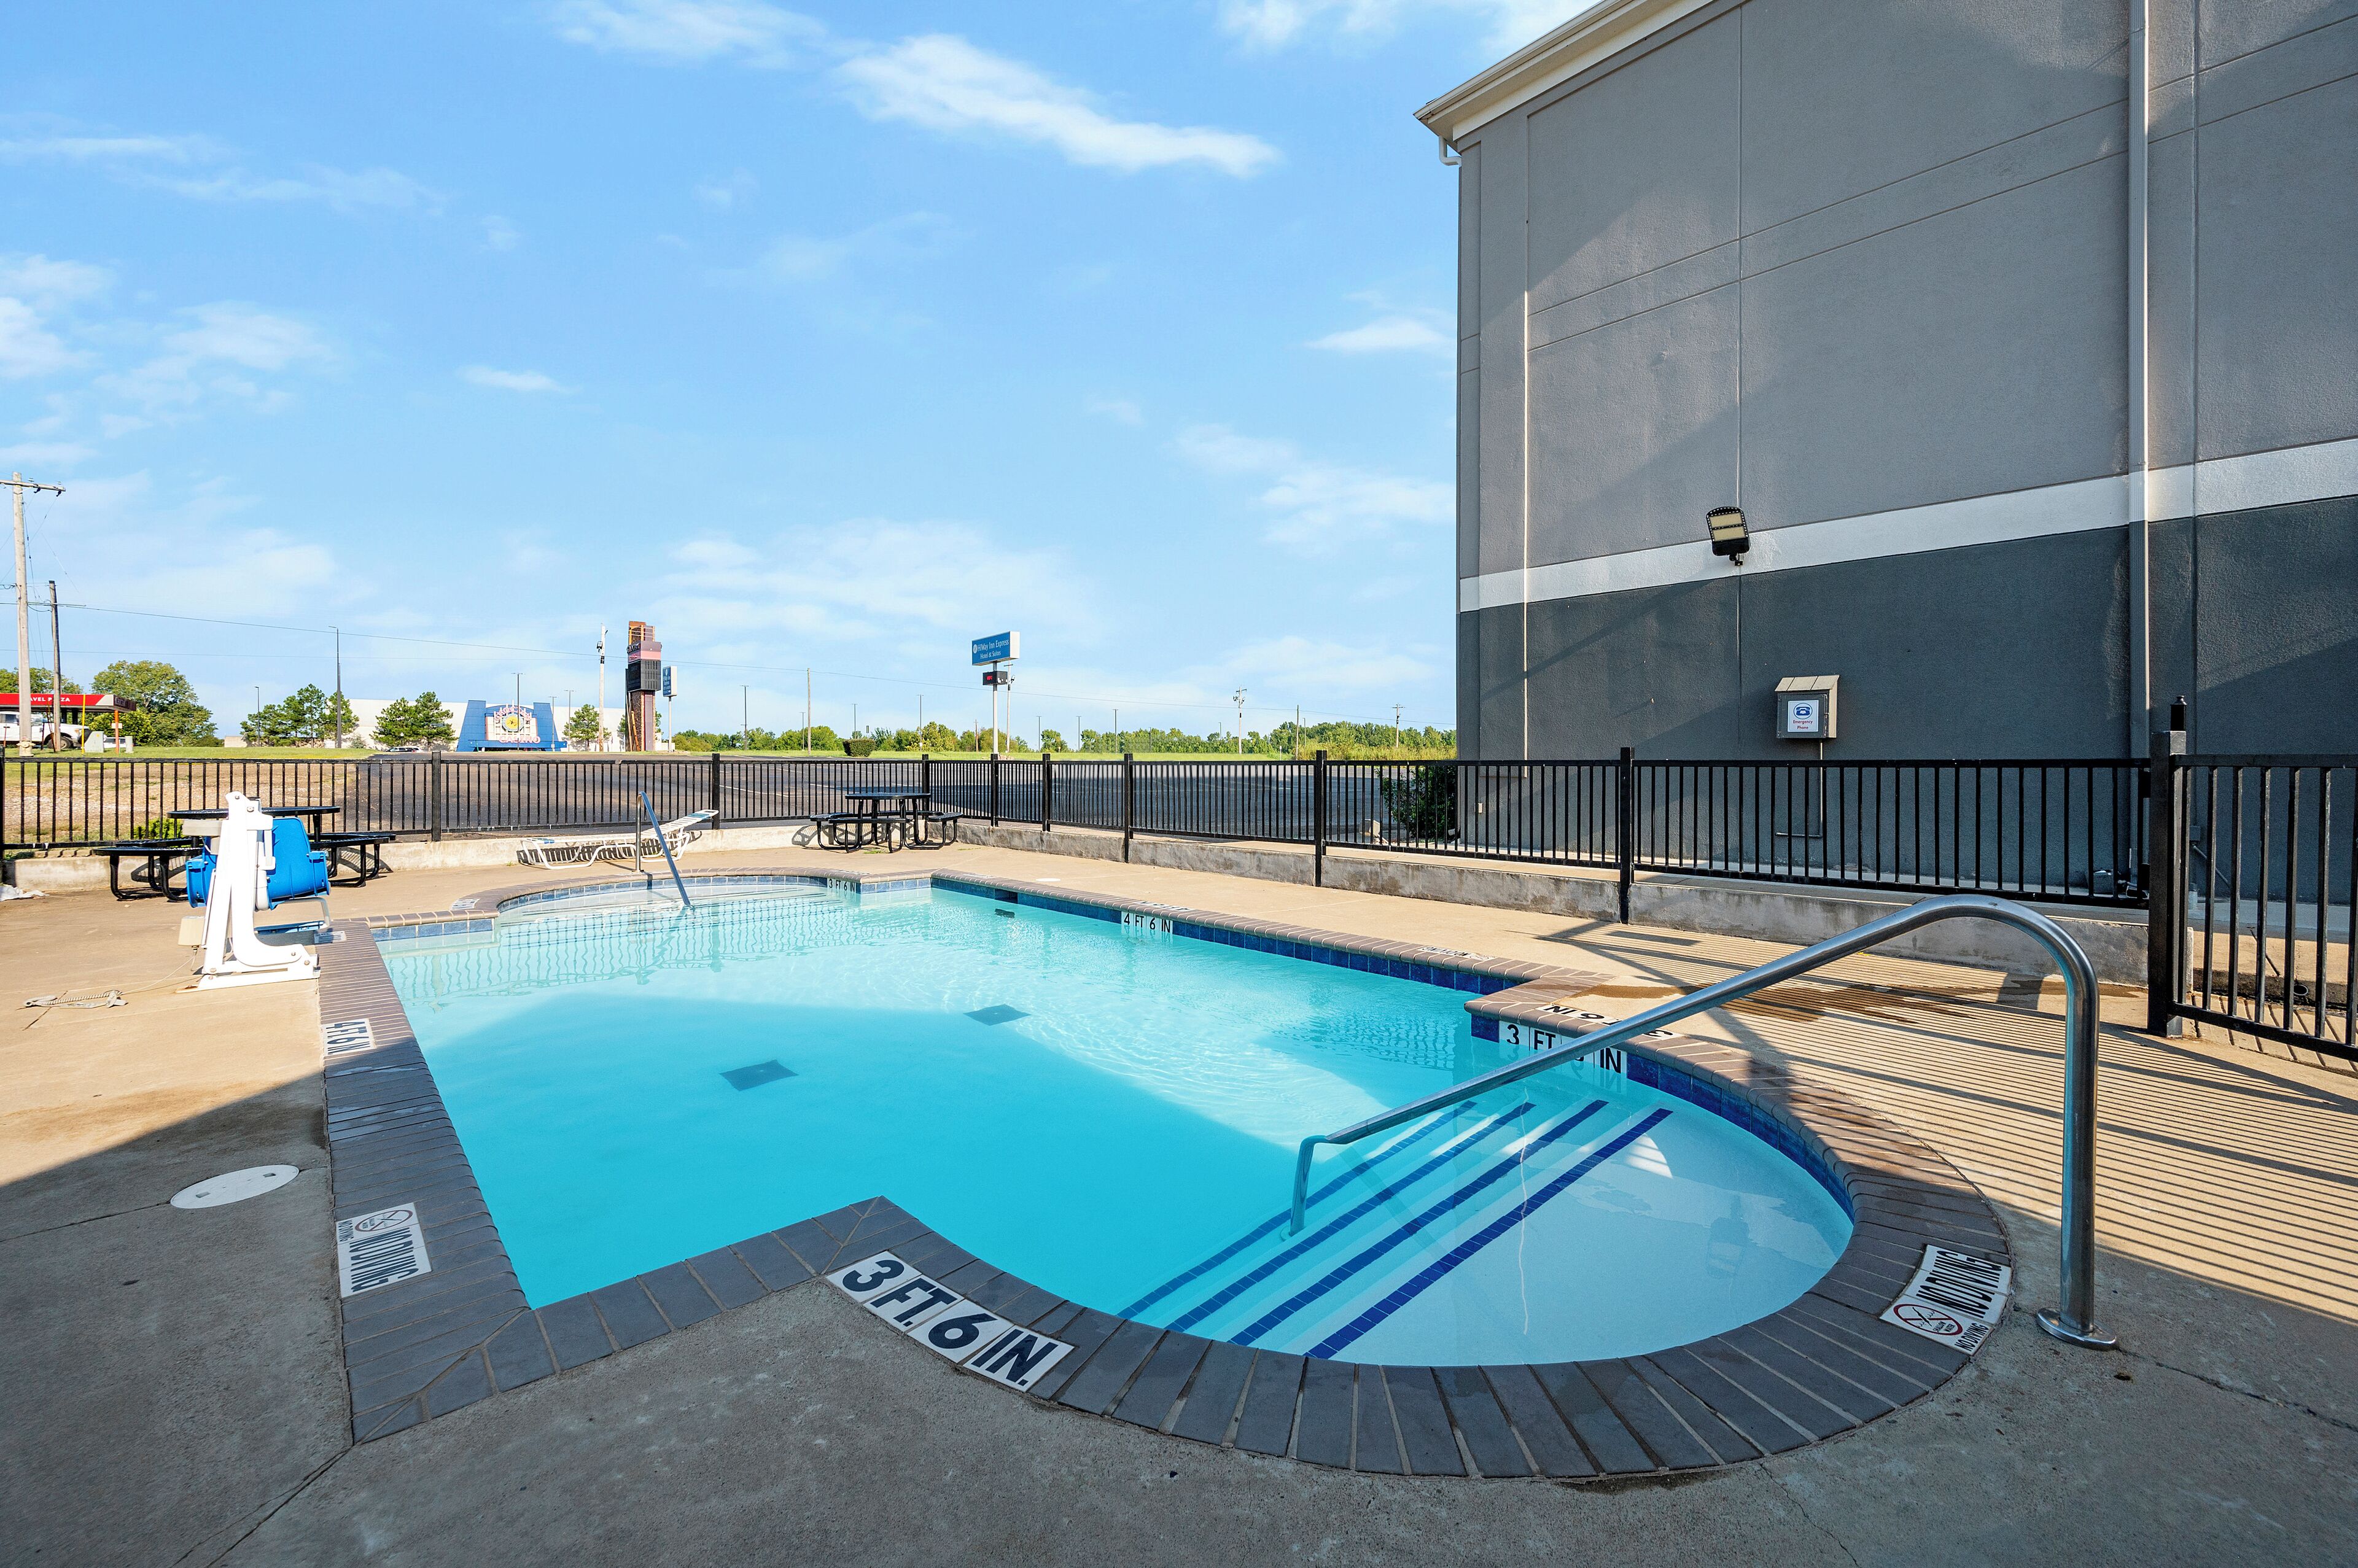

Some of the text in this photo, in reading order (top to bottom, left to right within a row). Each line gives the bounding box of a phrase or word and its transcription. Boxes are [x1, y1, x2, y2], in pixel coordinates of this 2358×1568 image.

[996, 639, 1009, 648] Express
[829, 879, 855, 892] 3 FT 6 IN
[1124, 913, 1170, 933] 4 FT 6 IN
[327, 1036, 369, 1045] 6
[1506, 1024, 1556, 1050] 3 FT
[1600, 1047, 1621, 1074] IN
[349, 1227, 419, 1292] NO DIVING
[1916, 1251, 2002, 1319] NO DIVING
[842, 1259, 1059, 1386] 3 FT. 6 IN.
[1955, 1322, 1989, 1351] NO DIVING
